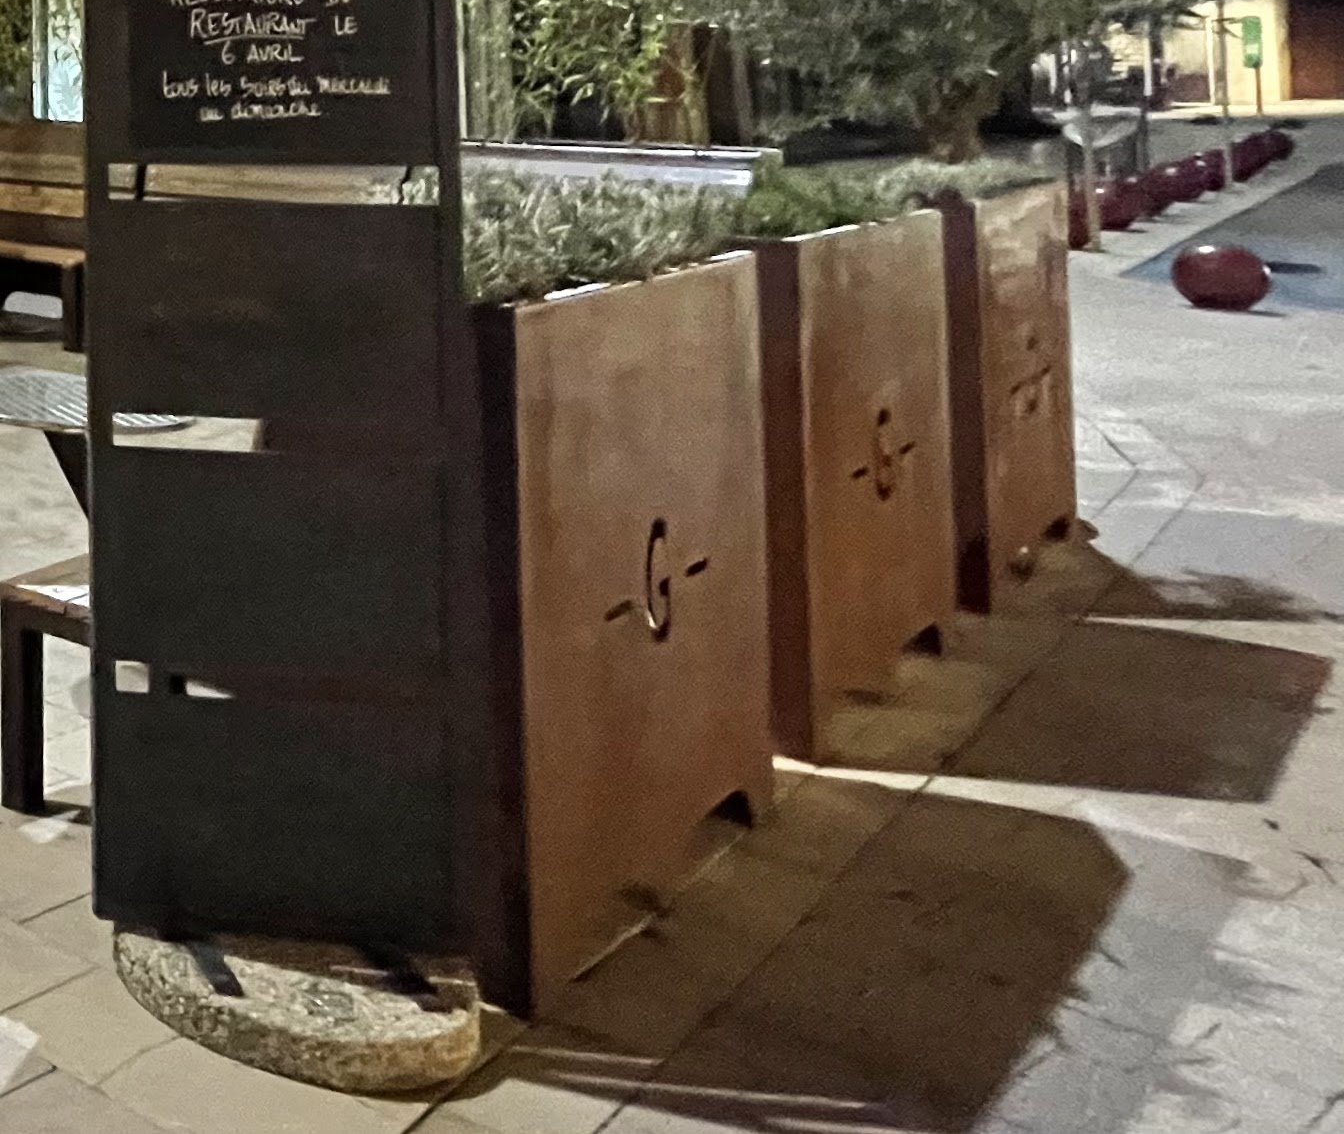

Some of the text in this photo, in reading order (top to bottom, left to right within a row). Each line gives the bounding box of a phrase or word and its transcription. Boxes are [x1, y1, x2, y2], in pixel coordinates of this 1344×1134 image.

[190, 9, 359, 40] RESTAURANT LE
[221, 41, 306, 66] 6 AVRIL
[162, 71, 199, 99] tous
[205, 73, 232, 97] les
